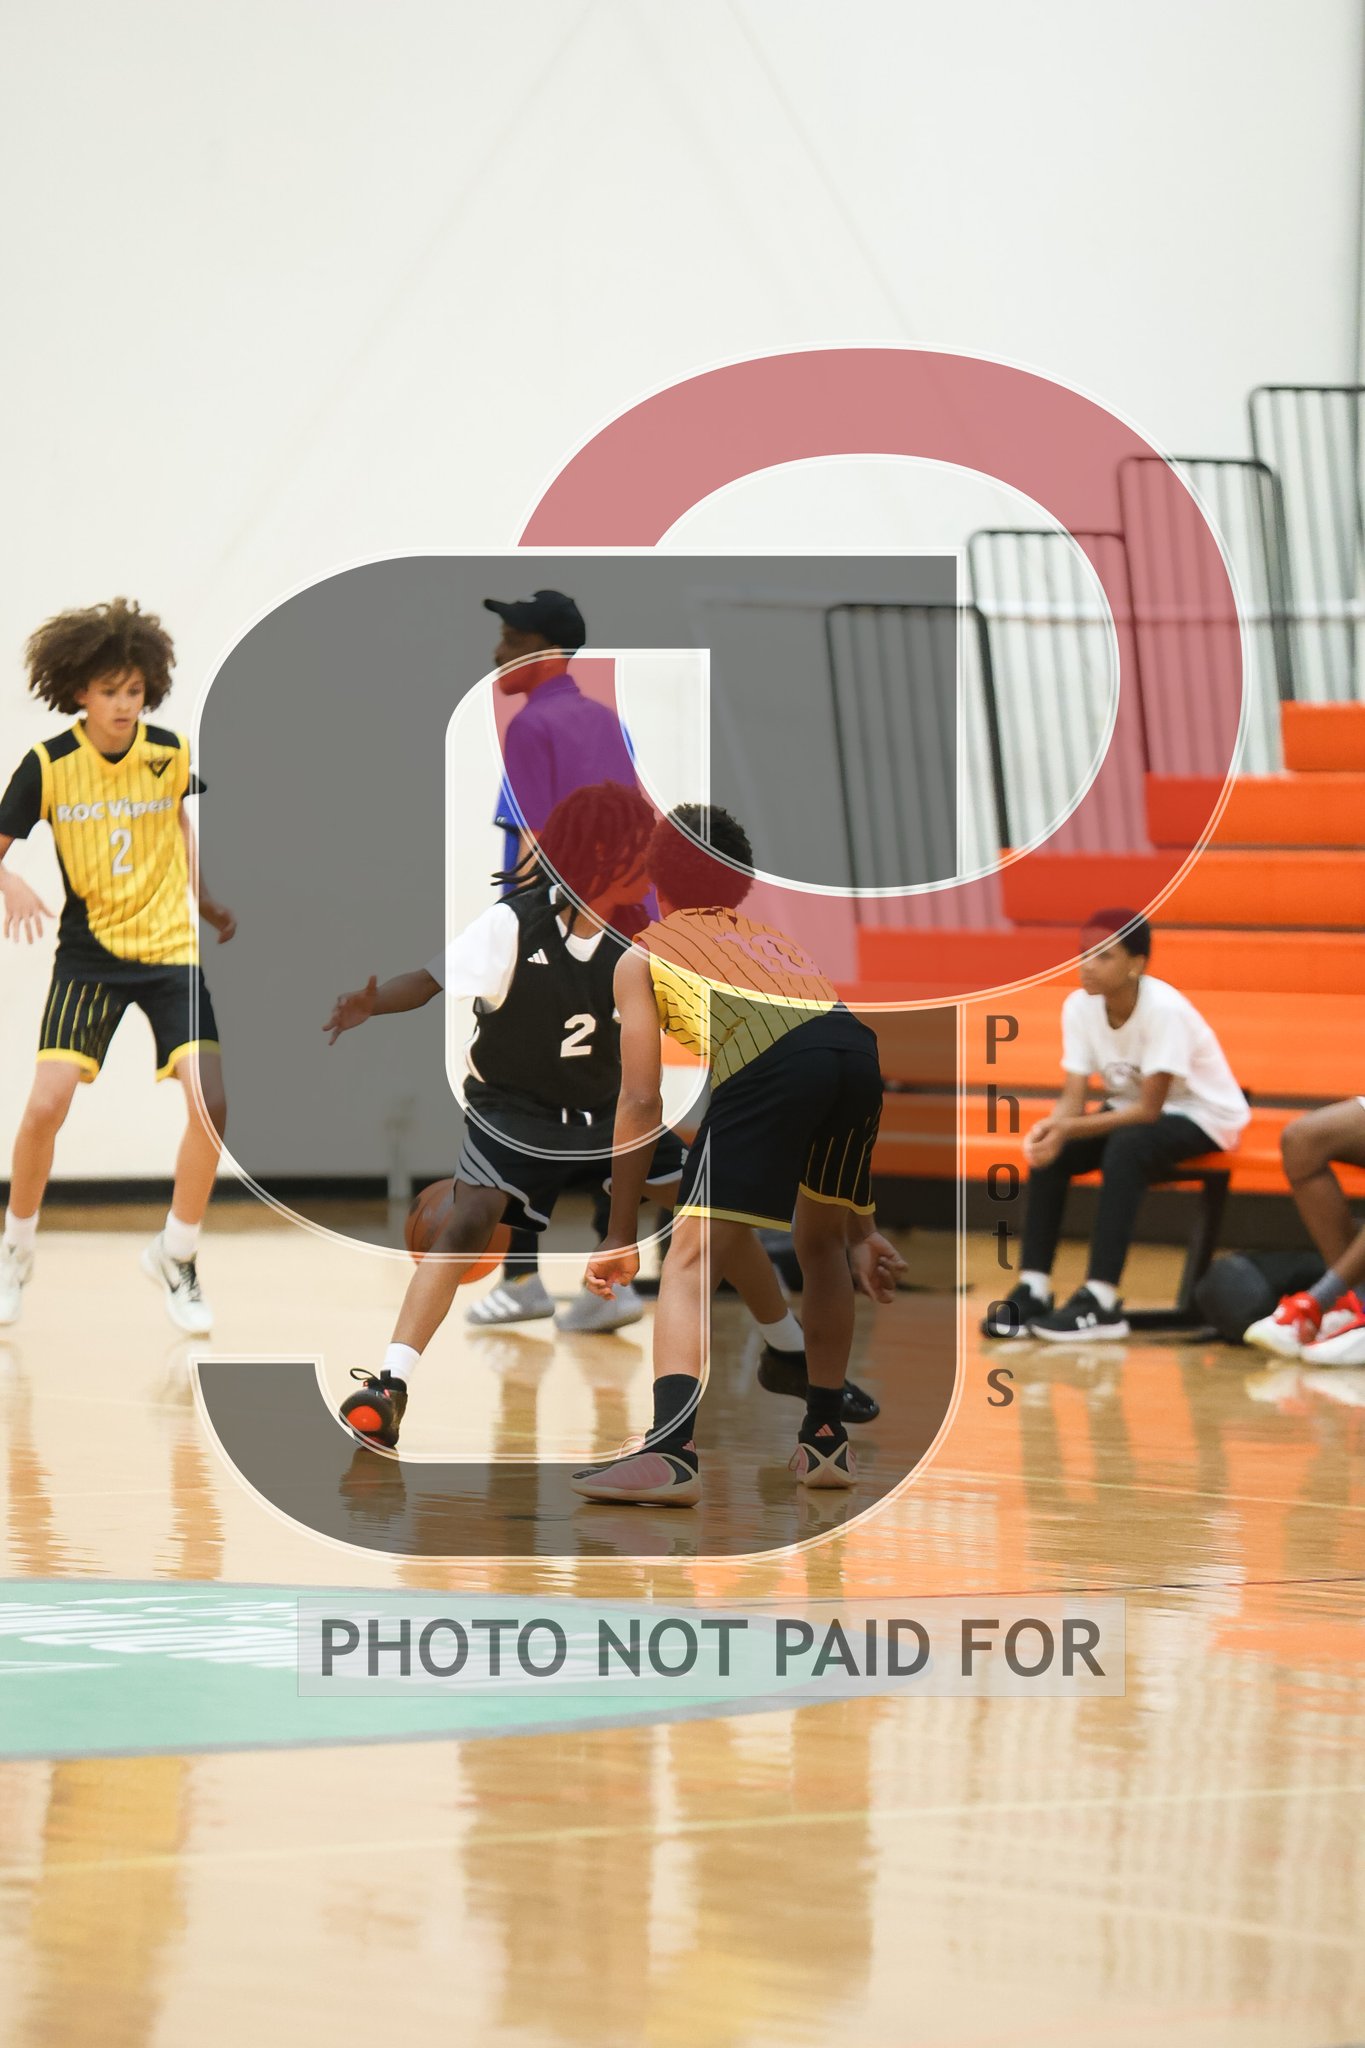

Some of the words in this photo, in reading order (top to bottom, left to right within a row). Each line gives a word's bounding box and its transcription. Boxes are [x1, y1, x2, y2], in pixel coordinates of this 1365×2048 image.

[57, 802, 105, 822] ROC
[110, 829, 134, 877] 2
[560, 1013, 597, 1057] 2
